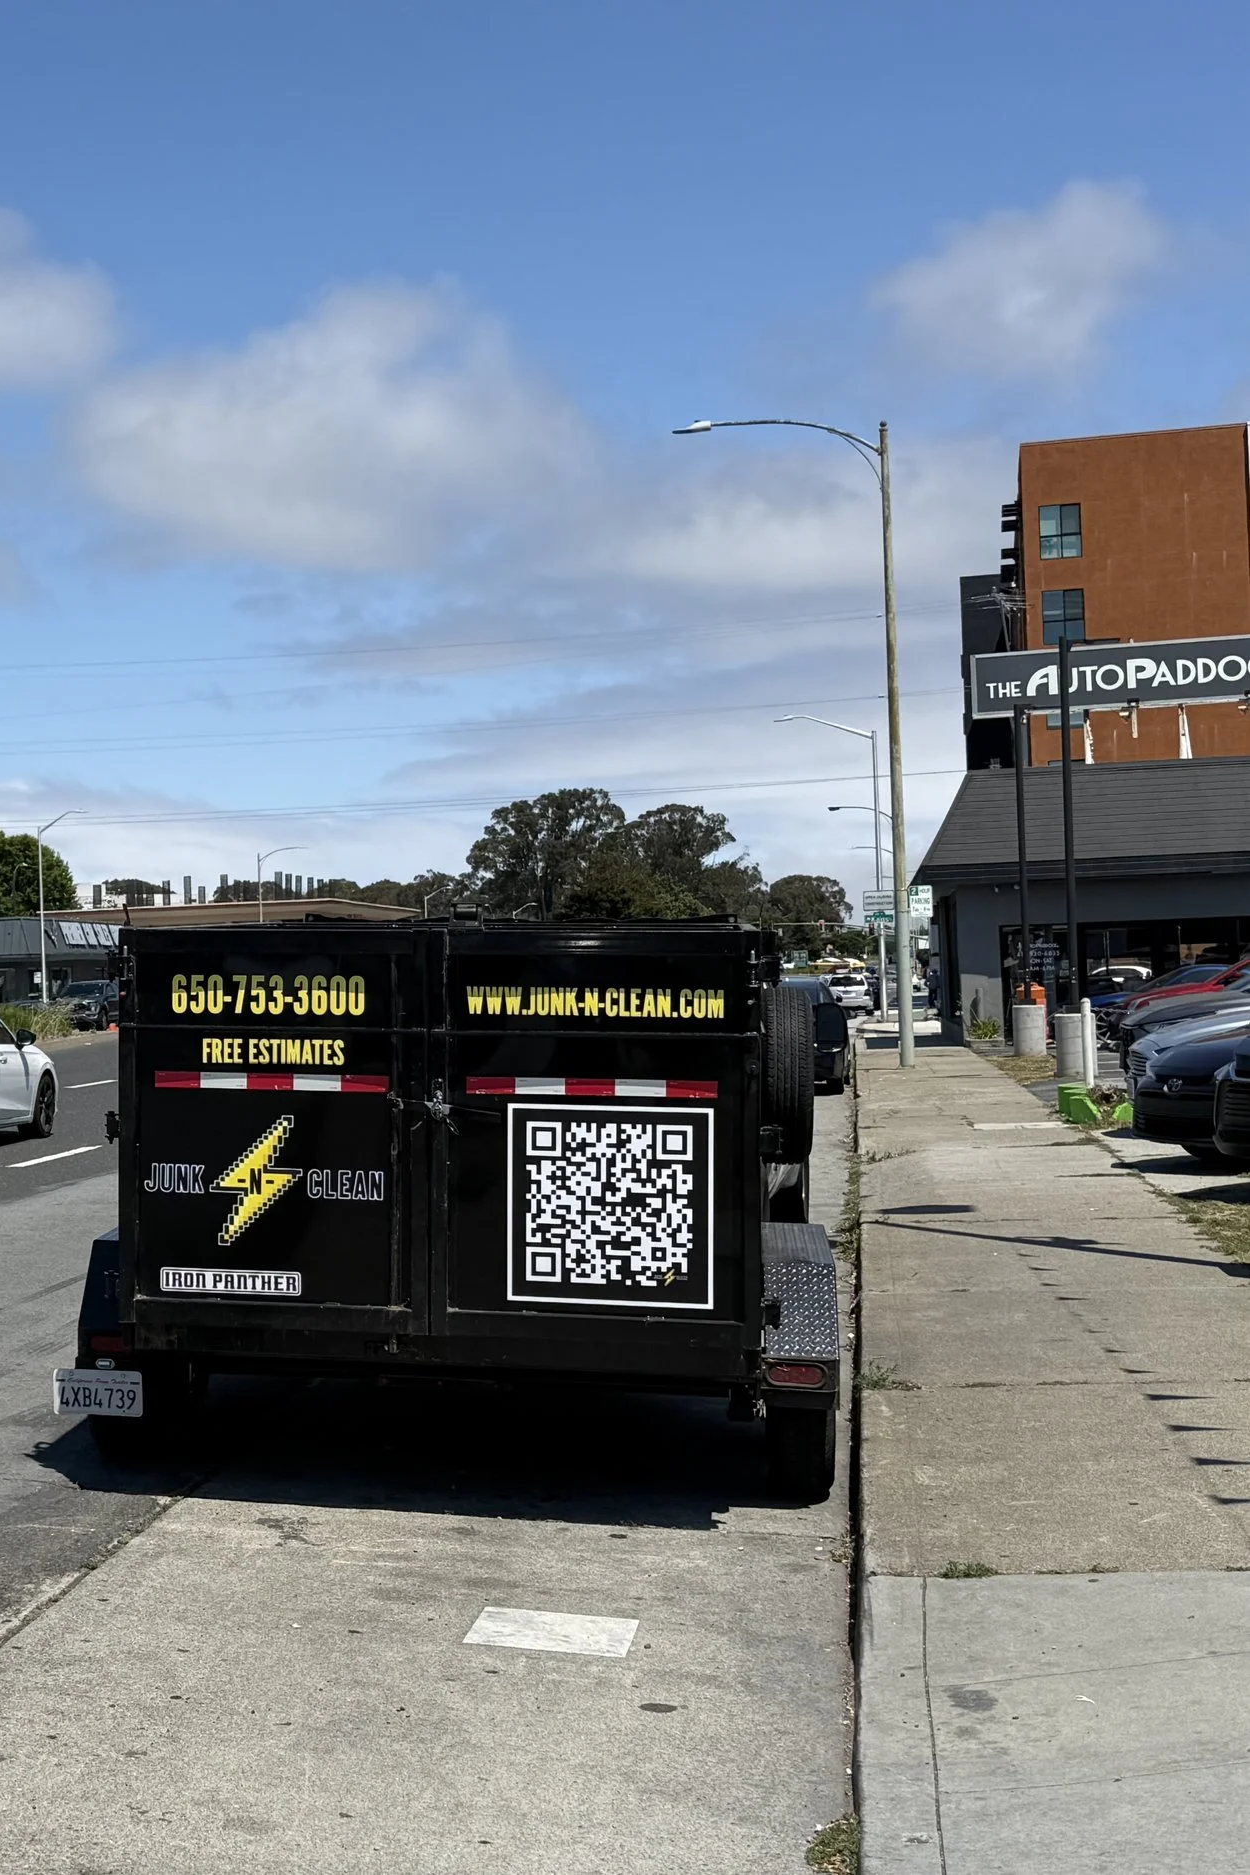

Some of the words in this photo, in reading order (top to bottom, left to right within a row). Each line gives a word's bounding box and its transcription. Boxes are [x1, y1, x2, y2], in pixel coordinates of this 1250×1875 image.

[986, 681, 1021, 699] THE
[1026, 655, 1250, 697] AUTOPADDO
[172, 974, 365, 1016] 650-753-3600
[466, 986, 725, 1019] WWW.JUNK-N-CLEAN.COM
[202, 1038, 243, 1064] FREE
[248, 1038, 345, 1065] ESTIMATES
[144, 1163, 205, 1194] JUNK
[307, 1169, 384, 1201] CLEAN
[164, 1271, 207, 1289] IRON
[212, 1273, 298, 1292] PANTHER
[60, 1386, 137, 1410] 4XB4739
